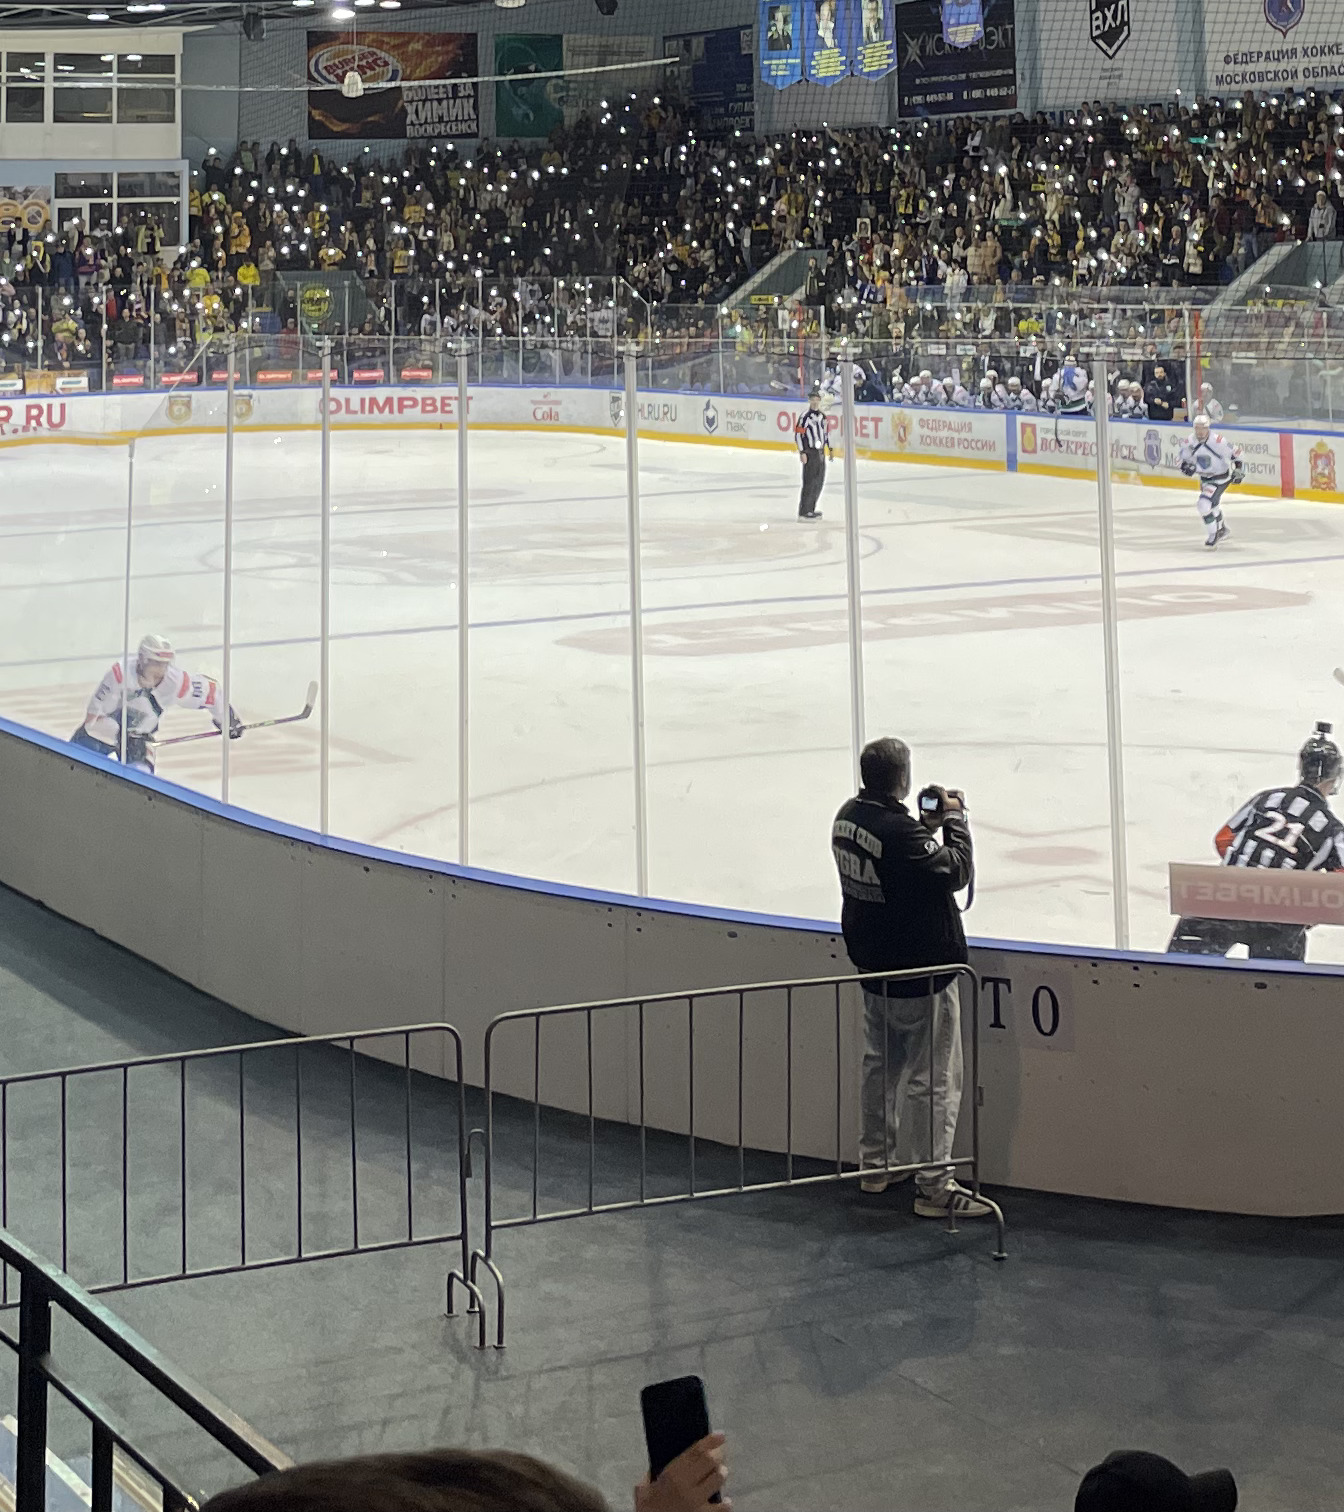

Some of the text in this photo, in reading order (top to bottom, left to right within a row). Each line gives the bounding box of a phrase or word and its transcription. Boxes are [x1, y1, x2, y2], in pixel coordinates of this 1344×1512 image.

[324, 51, 378, 76] BURGER
[1224, 47, 1298, 65] ФЕДЕРАЦИЯ
[334, 57, 390, 83] KNG
[1216, 66, 1298, 86] МОСКОВСКОЙ
[457, 82, 474, 97] ЗА
[406, 98, 477, 124] ХИМИК
[407, 120, 477, 137] ВОСКРЕСЕНСК
[319, 396, 473, 415] OLIMPBET
[533, 406, 560, 422] Cola
[918, 418, 973, 434] ФЕДЕРАЦИЯ
[920, 437, 996, 452] ХОККЕЯ РОССИИ
[1040, 437, 1136, 460] ВОСКРЕСНСК
[1239, 443, 1269, 455] оккея
[1255, 810, 1307, 855] 21
